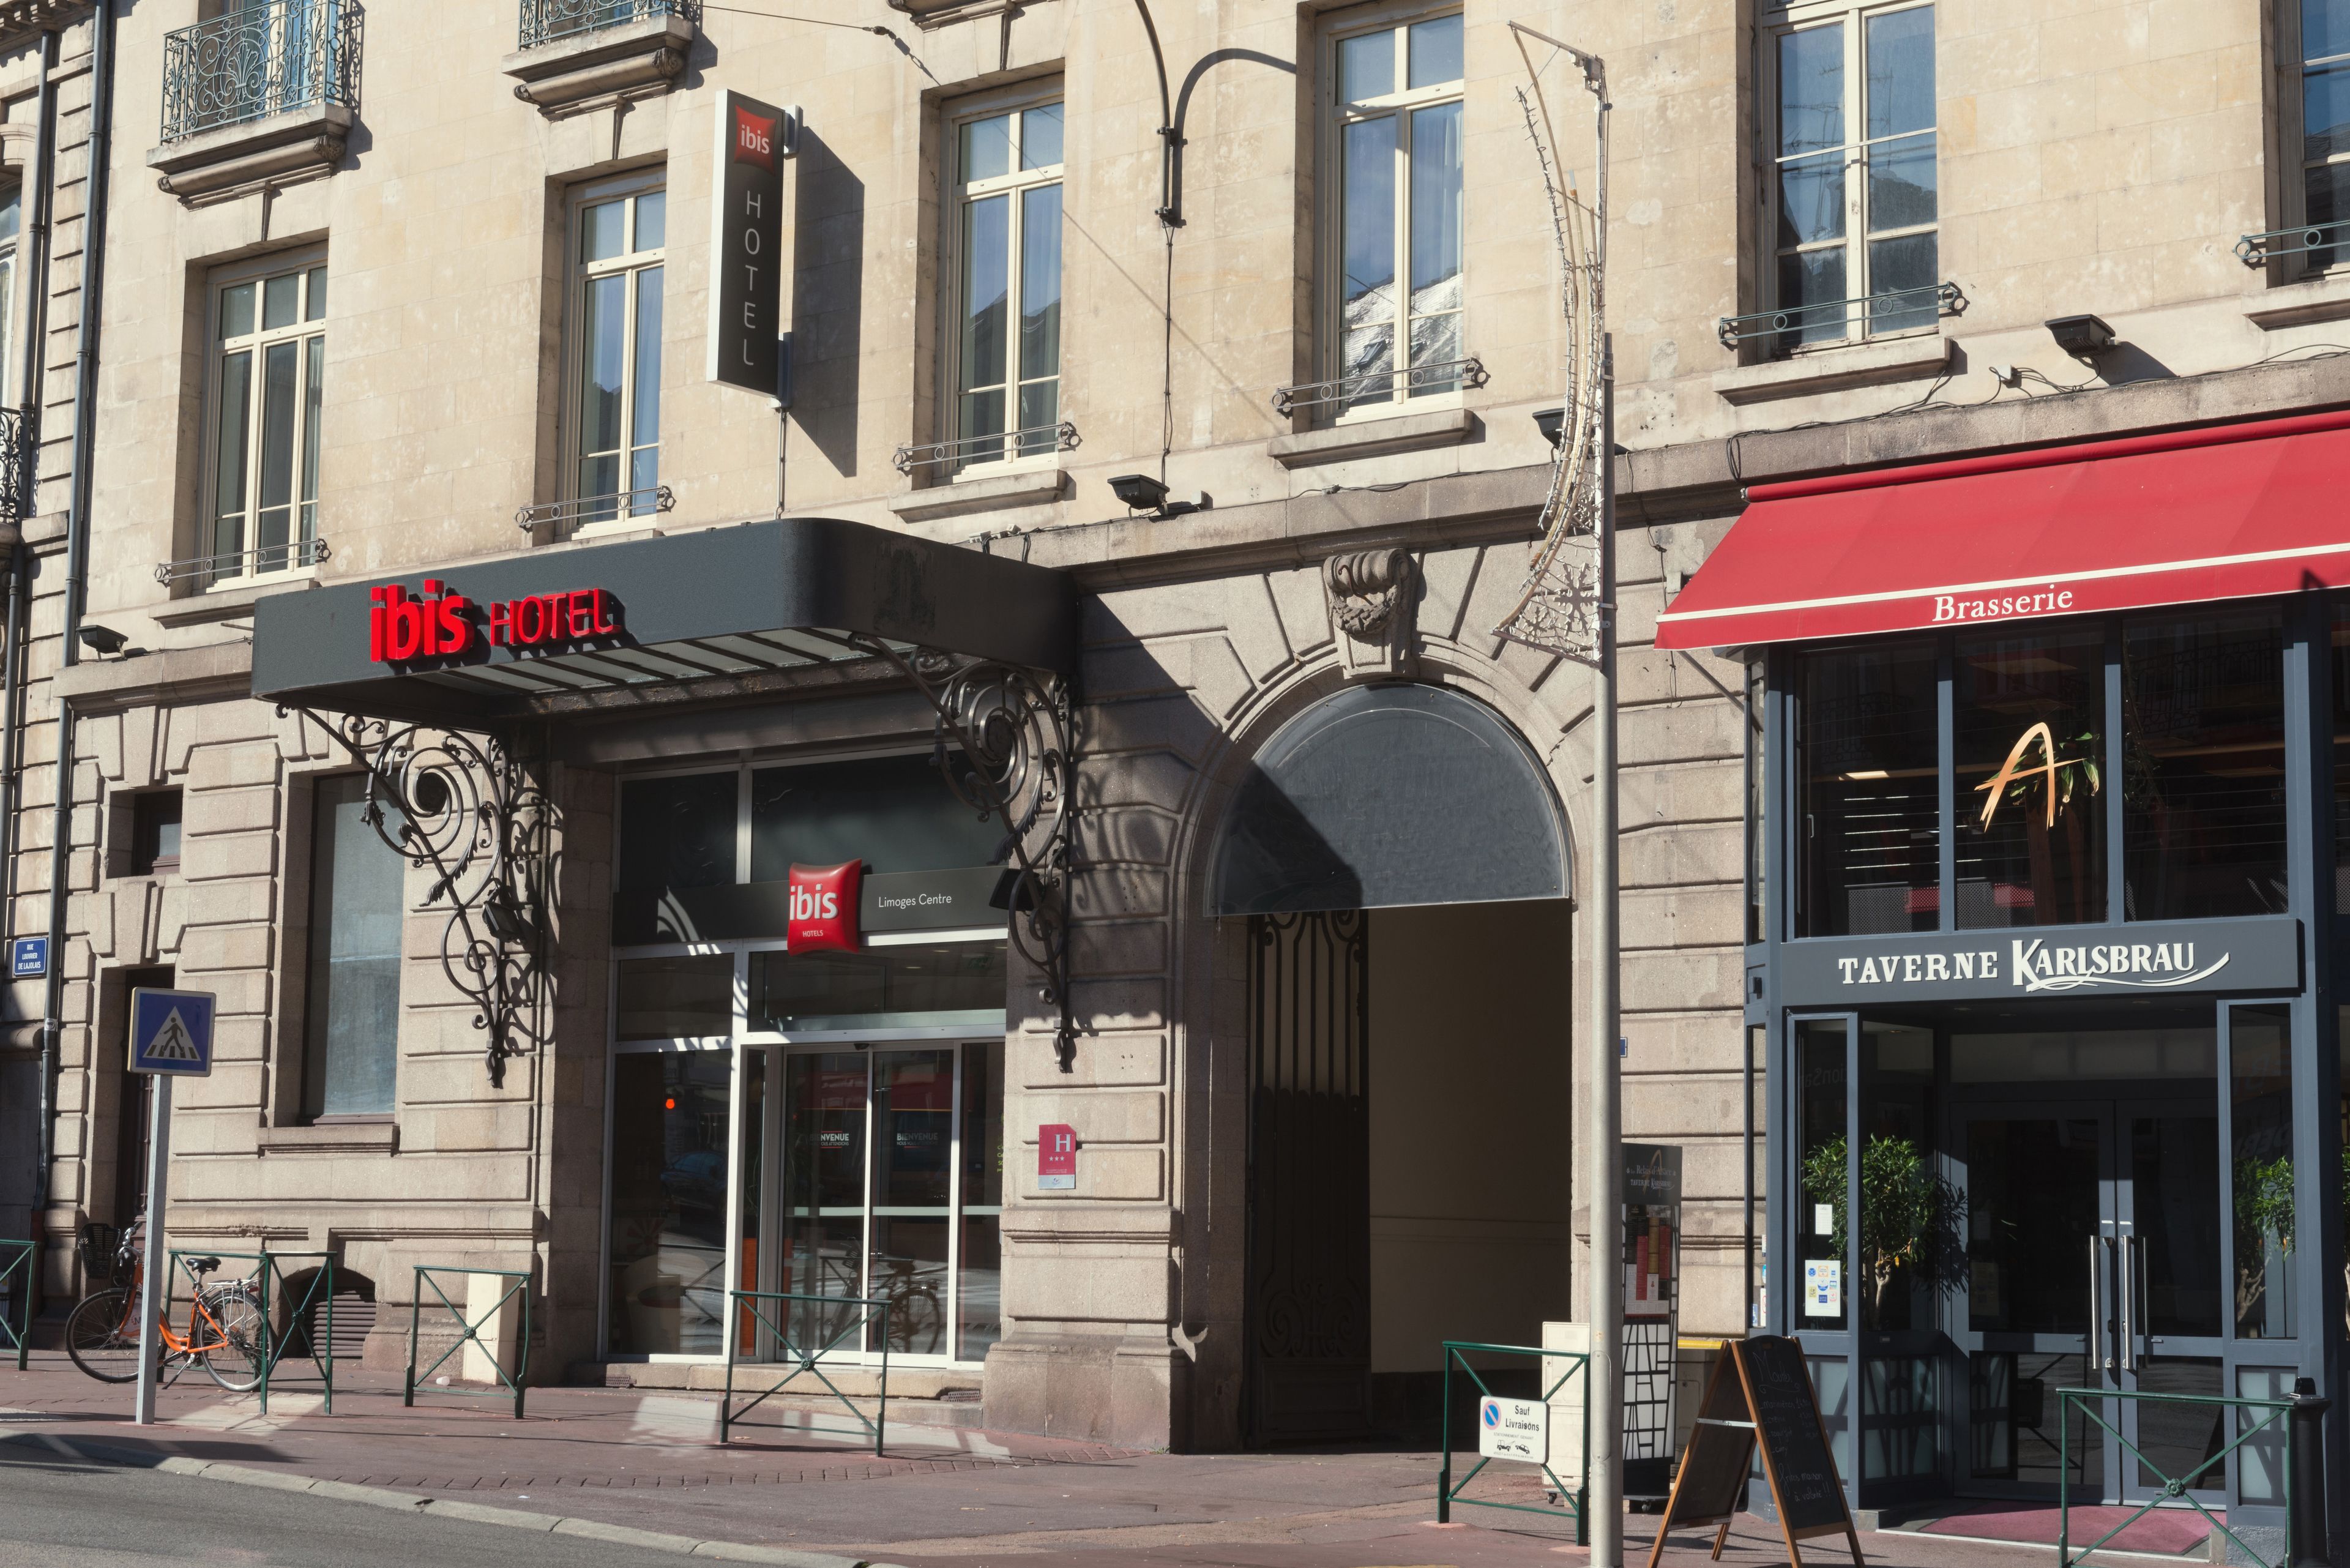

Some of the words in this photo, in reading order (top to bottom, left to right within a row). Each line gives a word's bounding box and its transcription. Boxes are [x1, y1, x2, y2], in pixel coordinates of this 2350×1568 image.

[740, 124, 770, 155] ibis
[744, 190, 761, 366] HOTEL
[1932, 584, 2073, 621] Brasserie
[371, 579, 474, 662] ibis
[490, 588, 622, 647] HOTEL
[789, 884, 838, 920] ibis
[879, 896, 916, 909] Limoges
[919, 893, 952, 905] Centre
[23, 961, 41, 969] LAJOLAIS
[1838, 952, 1999, 984] TAVERNE
[1054, 1134, 1072, 1152] H
[1505, 1418, 1540, 1432] Livraisons
[1515, 1405, 1530, 1416] Sauf
